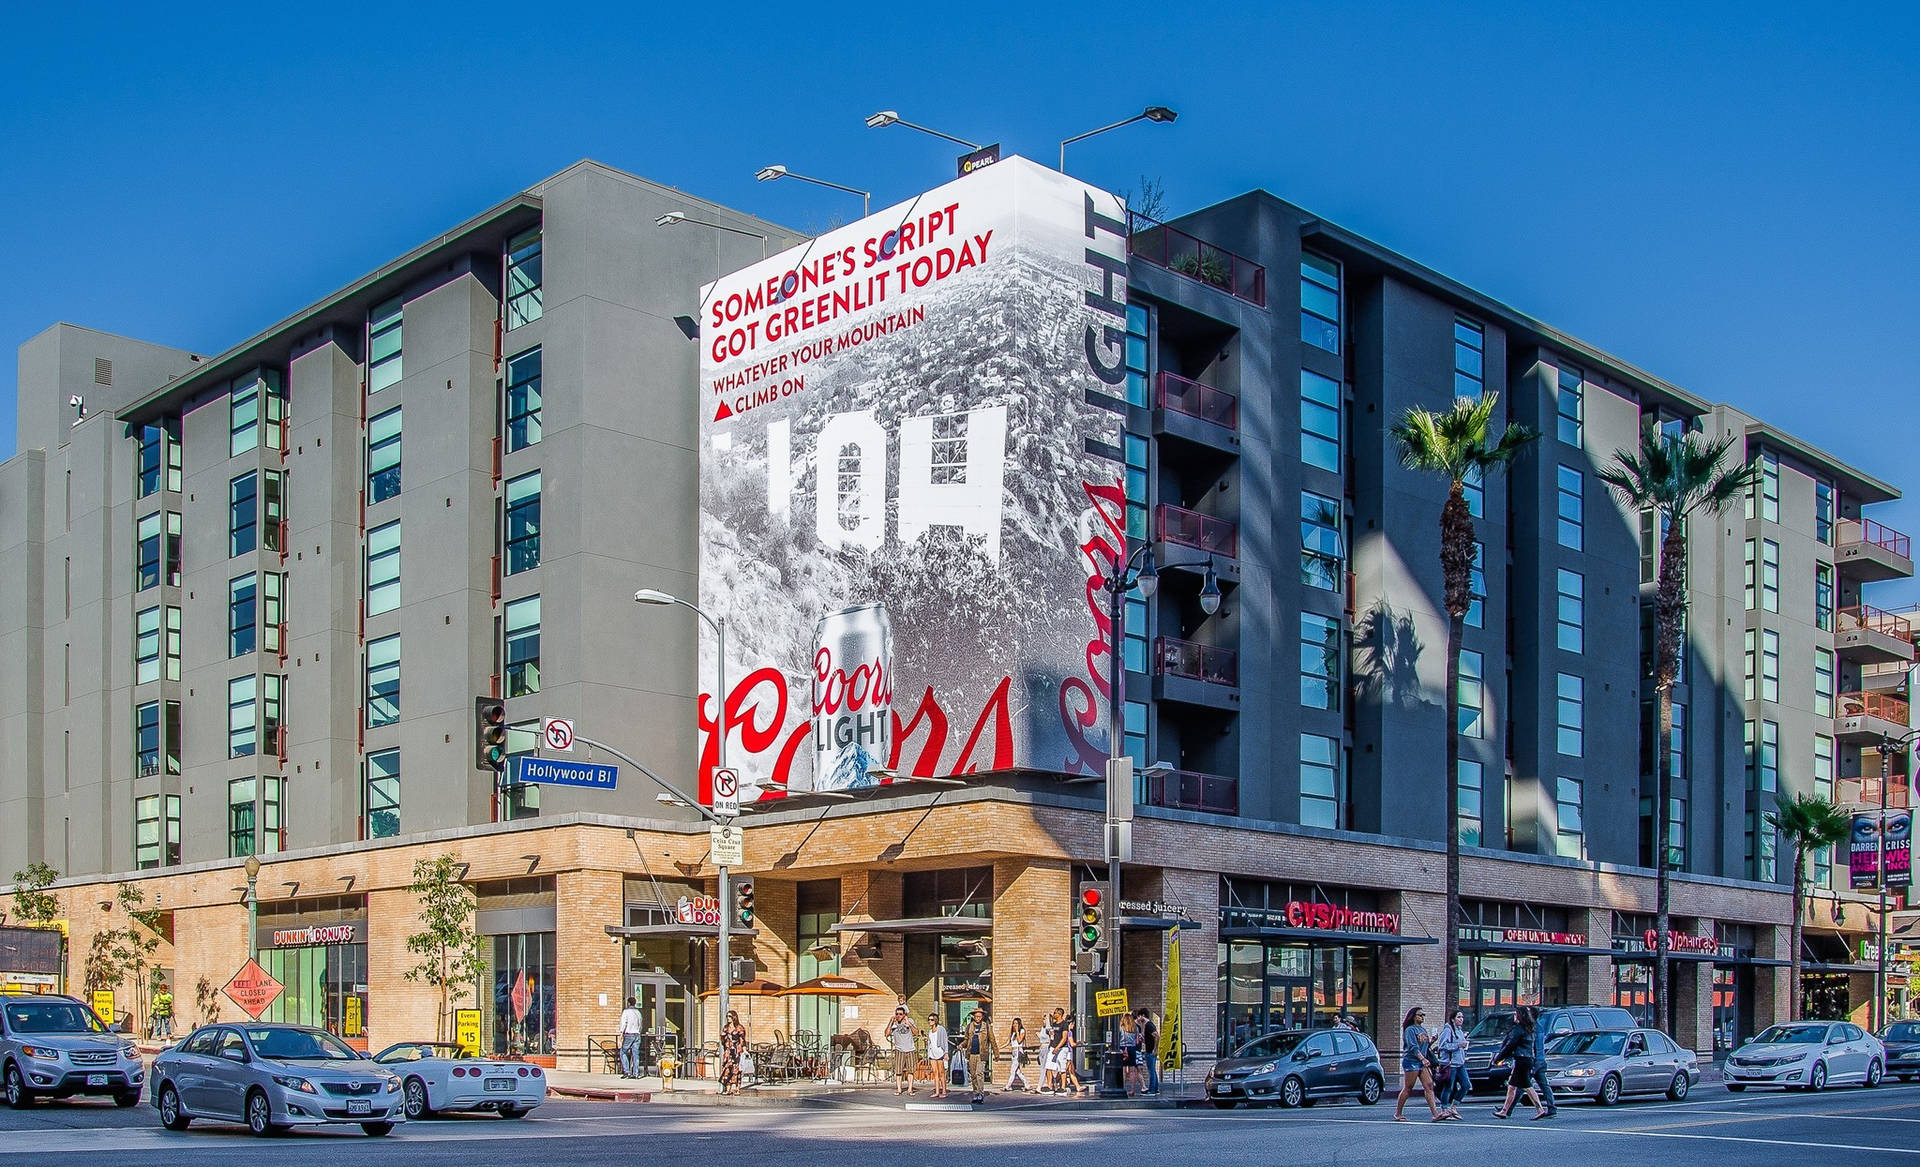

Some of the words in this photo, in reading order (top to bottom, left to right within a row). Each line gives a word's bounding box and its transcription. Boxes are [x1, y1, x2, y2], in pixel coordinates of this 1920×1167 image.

[972, 155, 994, 170] PEARL
[712, 244, 855, 329] SOMEONE'S
[864, 202, 959, 268] SCRIPT
[712, 321, 756, 364] GOT
[765, 269, 894, 342] GREENLIT
[896, 229, 994, 294] TODAY
[1084, 190, 1126, 464] LIGHT
[713, 355, 788, 395] WHATEVER
[791, 338, 833, 367] YOUR
[837, 305, 924, 349] MOUNTAIN
[735, 381, 778, 414] CLIMB
[782, 375, 804, 396] ON
[812, 646, 893, 717] Coors
[697, 668, 1013, 805] Cors
[816, 709, 887, 751] LIGHT
[527, 764, 593, 783] Hollywood
[715, 801, 723, 809] ON
[725, 801, 737, 810] RED
[1885, 840, 1911, 851] CRISS
[1152, 901, 1187, 915] juicery
[1285, 901, 1399, 934] CVS/pharmacy
[315, 925, 351, 942] DONUTS
[1507, 929, 1528, 941] OPEN
[1529, 930, 1551, 943] UNTIL
[1644, 929, 1719, 952] CS/pharmacy
[240, 989, 266, 997] CLOSED
[255, 980, 273, 988] LANE
[243, 998, 265, 1006] AHEAD
